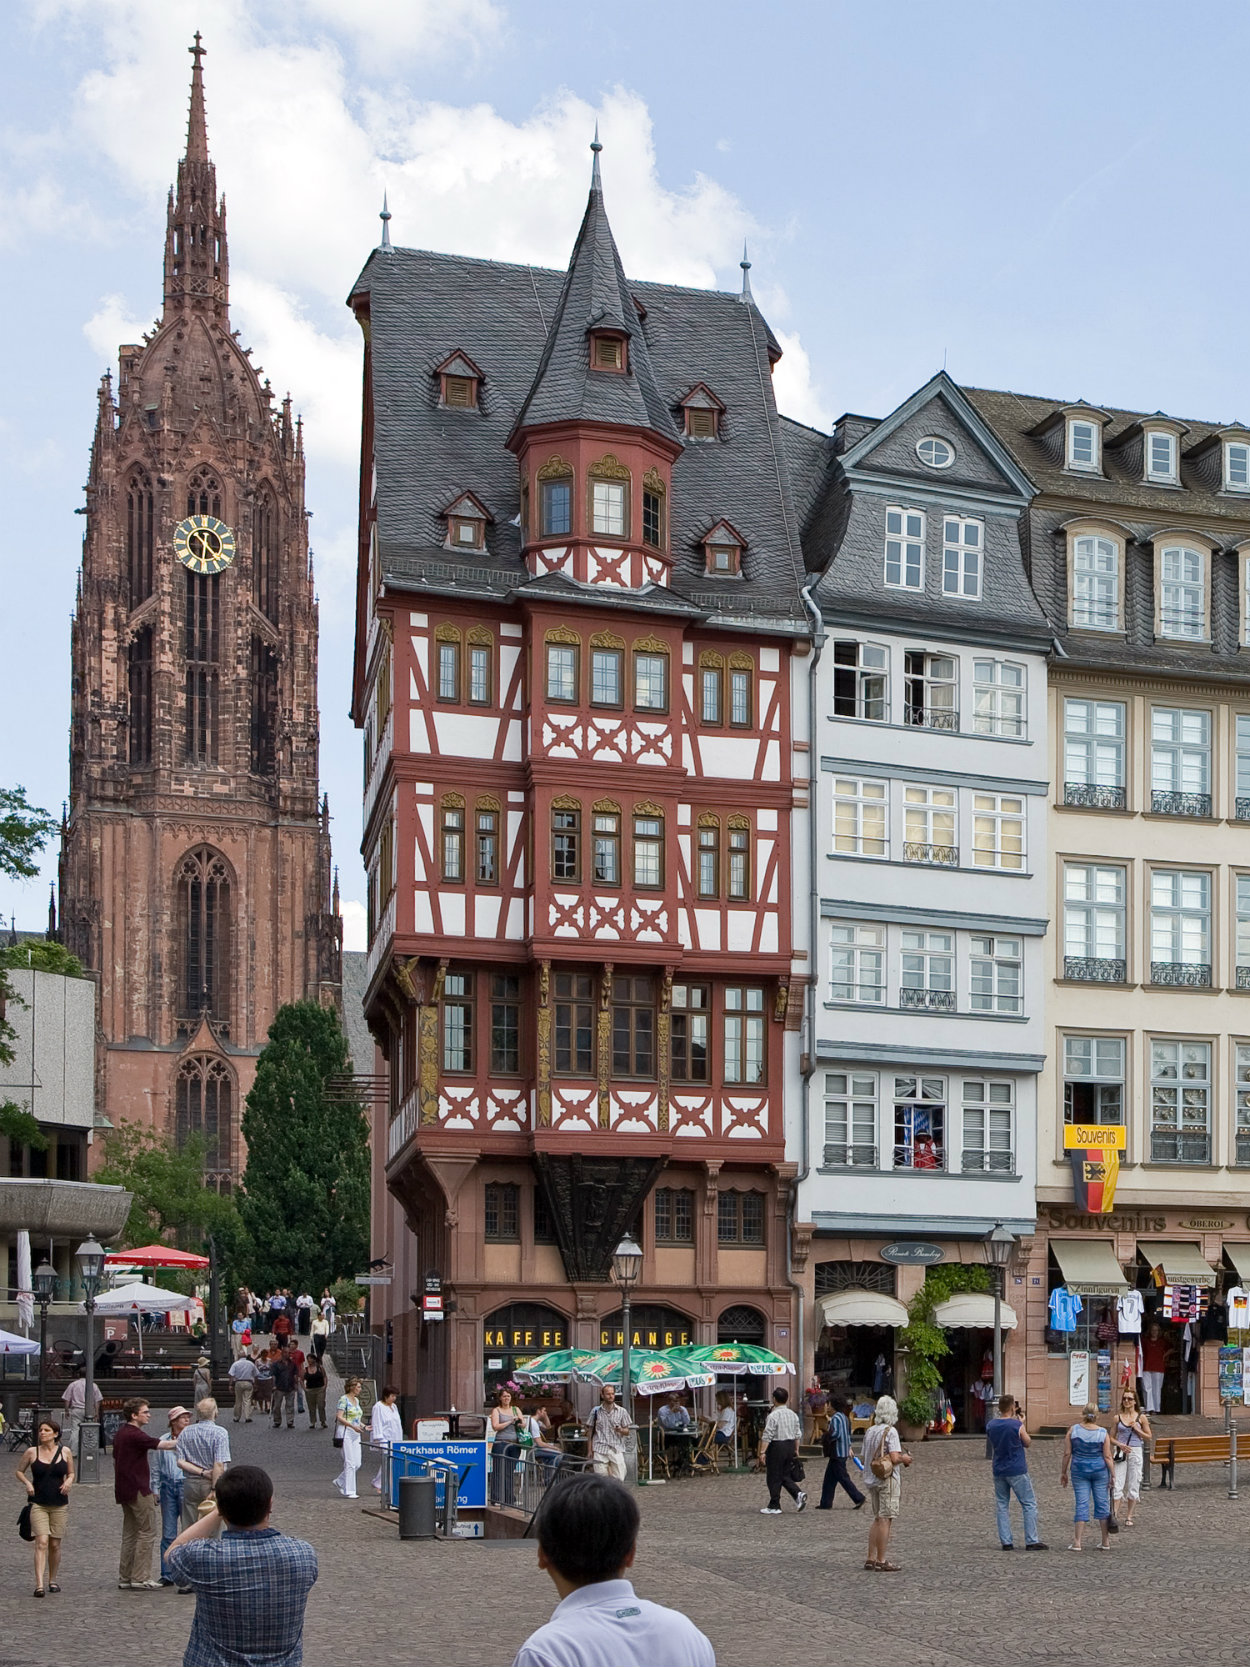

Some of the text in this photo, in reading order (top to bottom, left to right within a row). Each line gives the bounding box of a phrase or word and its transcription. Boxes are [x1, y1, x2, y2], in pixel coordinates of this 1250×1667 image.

[1076, 1127, 1116, 1144] Souvenirs
[1049, 1209, 1167, 1232] Souvenirs
[1166, 1274, 1210, 1284] unstgewerbe
[1126, 1299, 1135, 1314] 7
[107, 1329, 115, 1340] P
[485, 1331, 562, 1346] KAFFEE
[601, 1331, 688, 1346] CHANGE
[400, 1445, 478, 1454] Parkhaus Römer
